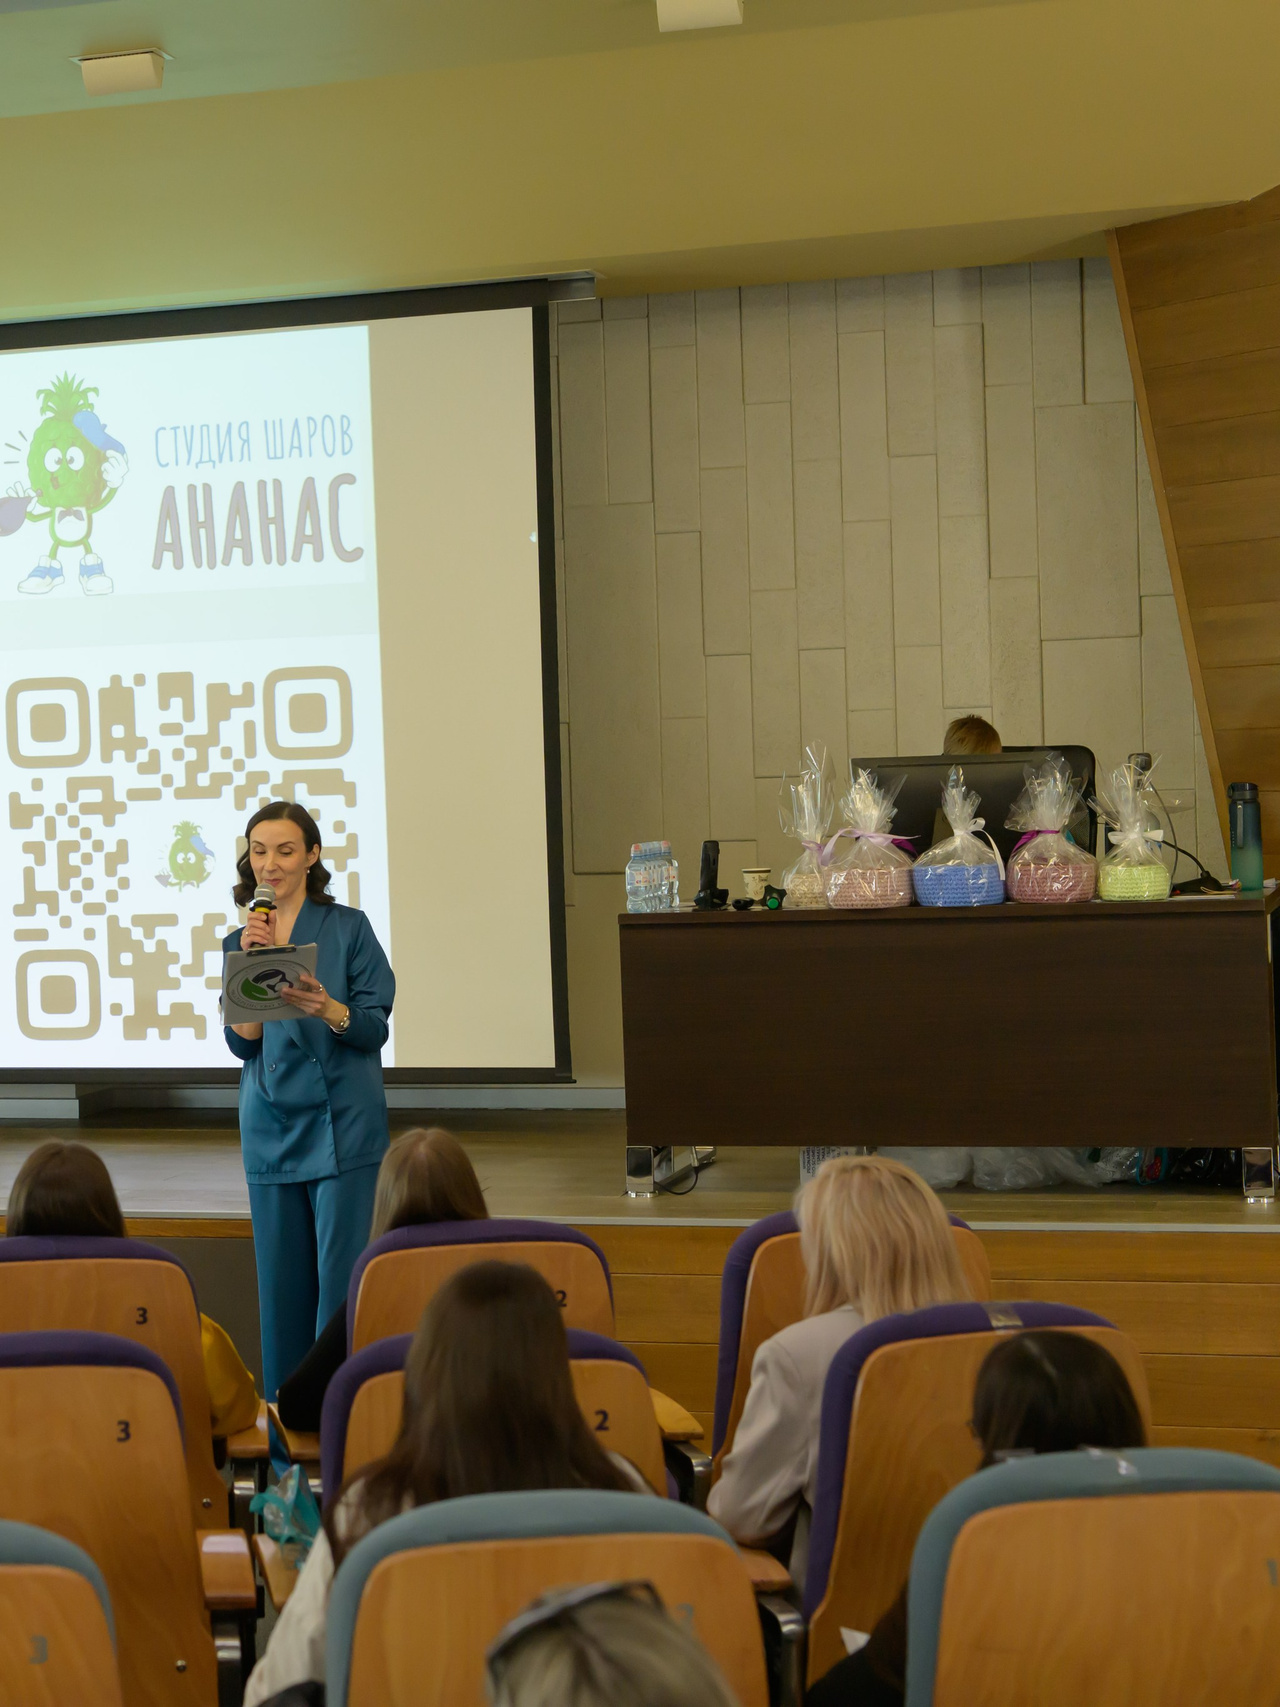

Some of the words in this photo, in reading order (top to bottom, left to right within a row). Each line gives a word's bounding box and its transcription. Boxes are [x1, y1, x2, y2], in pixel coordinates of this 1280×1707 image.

[154, 420, 251, 469] СТУДИЯ
[264, 414, 354, 460] ШАРОВ
[151, 472, 364, 570] АНАНАС
[554, 1289, 568, 1308] 2
[135, 1306, 149, 1325] 3
[116, 1420, 131, 1443] 3
[594, 1409, 610, 1432] 2
[29, 1635, 49, 1664] 3
